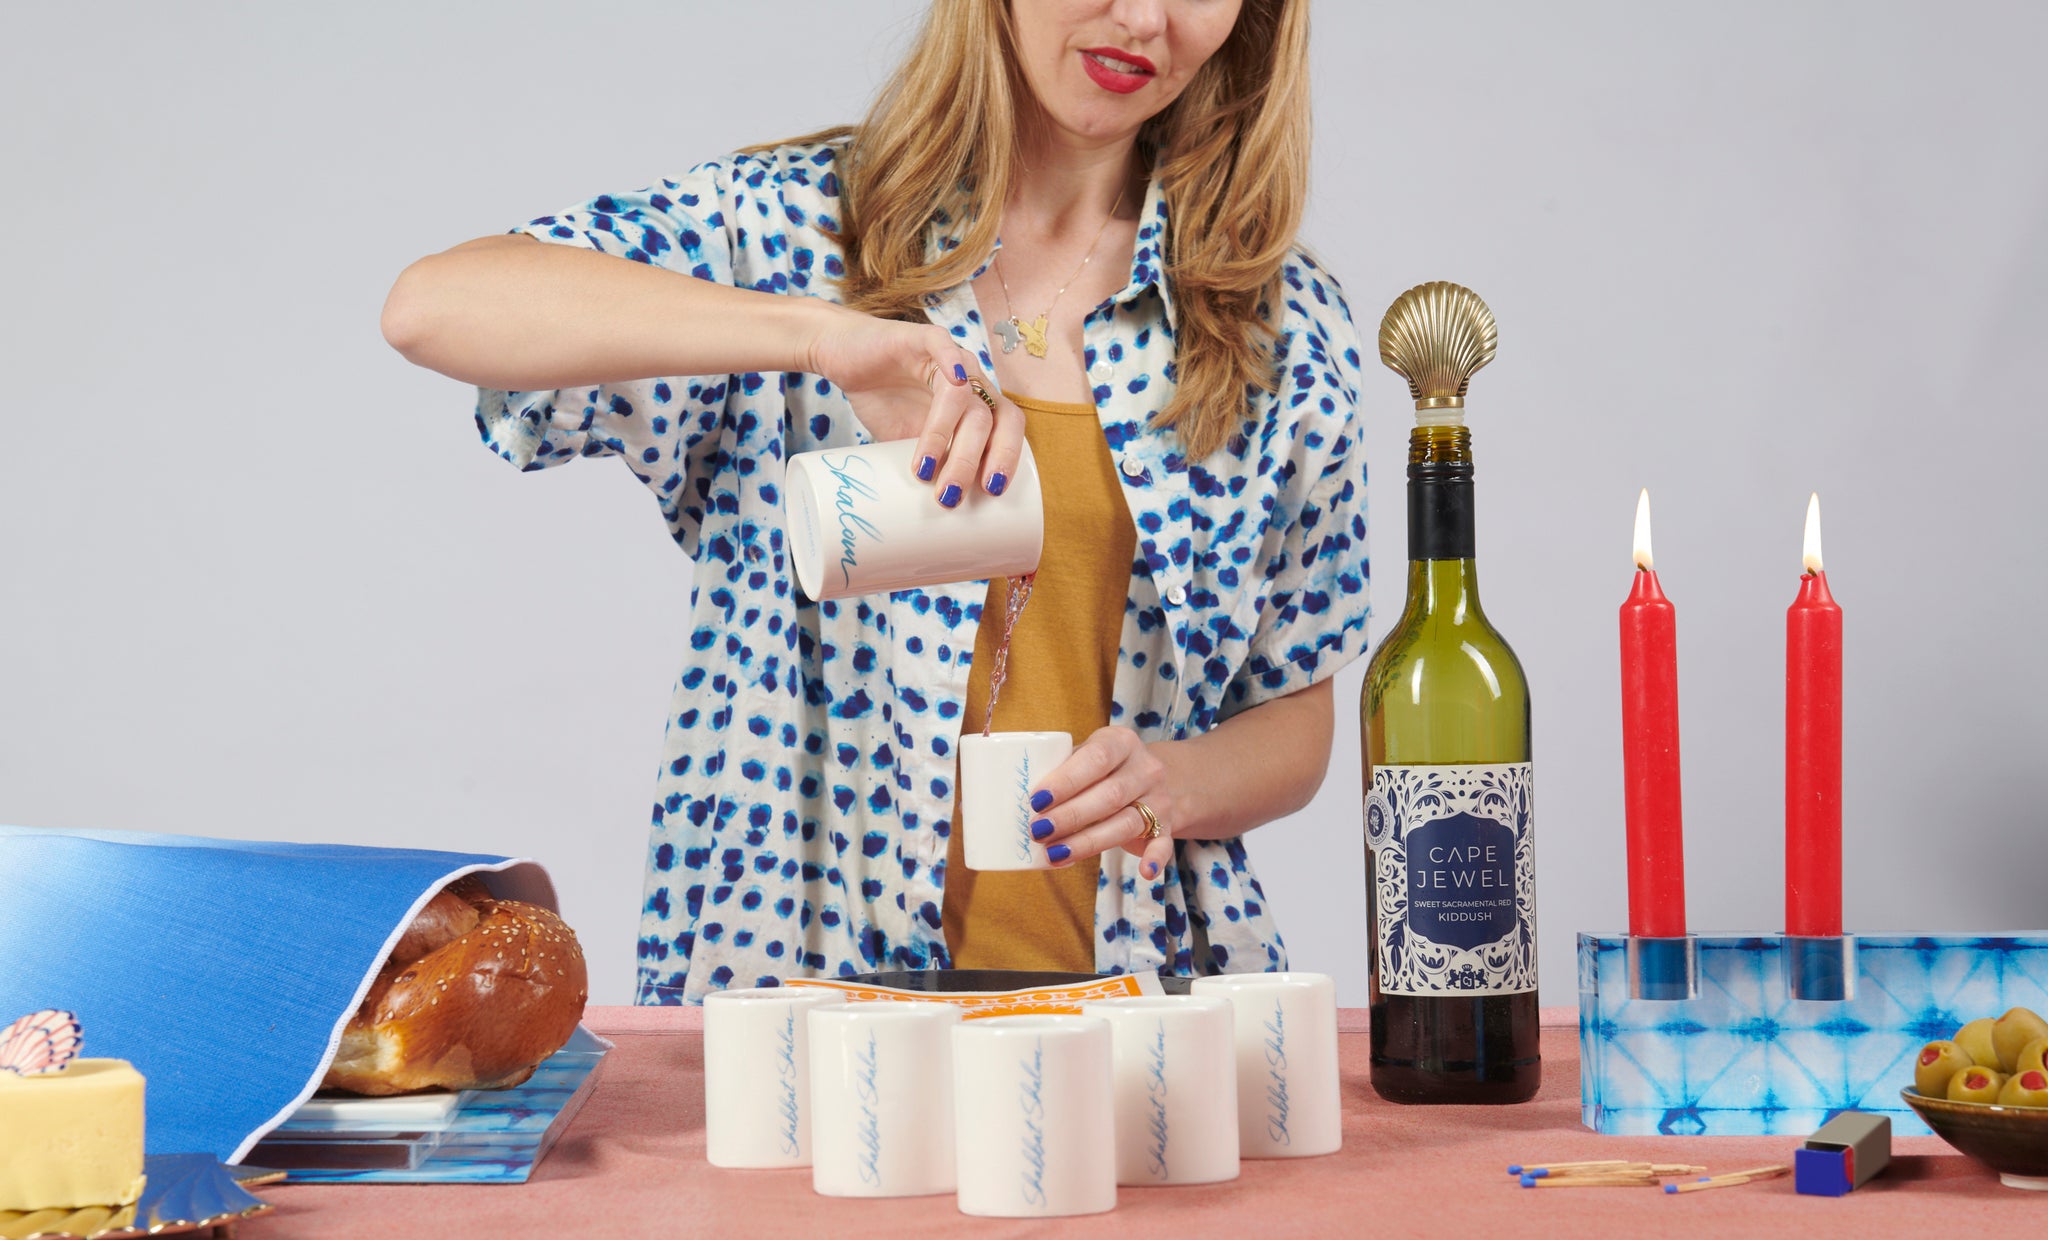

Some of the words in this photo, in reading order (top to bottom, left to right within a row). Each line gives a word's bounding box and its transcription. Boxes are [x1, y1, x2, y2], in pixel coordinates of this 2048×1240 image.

[821, 452, 884, 589] Shalom
[1416, 869, 1509, 889] JEWEL
[1429, 846, 1497, 864] CAPE
[1414, 900, 1440, 908] SWEET
[1441, 899, 1498, 908] SACRAMENTAL
[1498, 899, 1512, 907] RED
[1438, 911, 1492, 922] KIDDUSH
[780, 1080, 800, 1158] Shabbat
[860, 1105, 881, 1188] Shabbat
[1148, 1097, 1169, 1180] Shabbat
[1269, 1071, 1291, 1146] Shabbat
[1024, 1120, 1047, 1207] Shabbat
